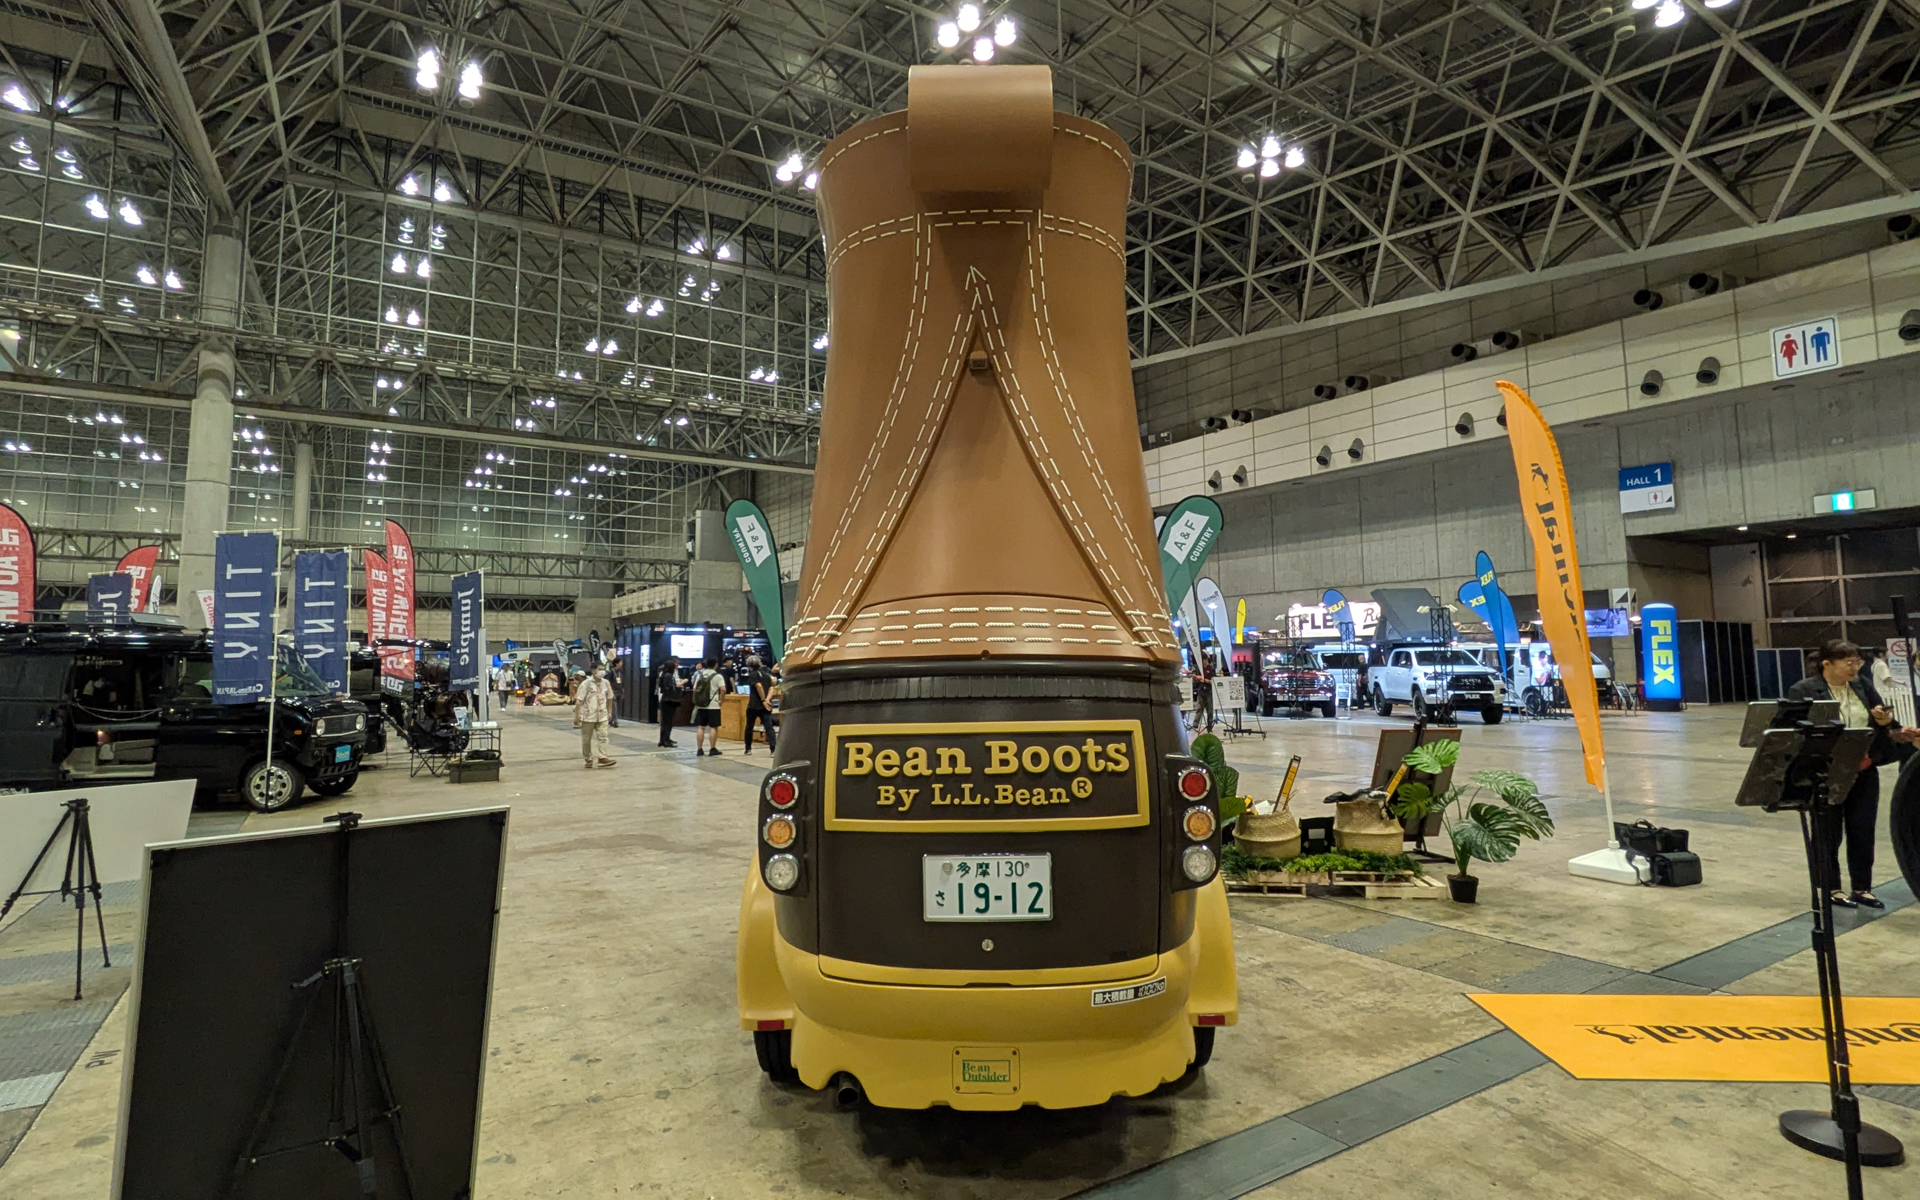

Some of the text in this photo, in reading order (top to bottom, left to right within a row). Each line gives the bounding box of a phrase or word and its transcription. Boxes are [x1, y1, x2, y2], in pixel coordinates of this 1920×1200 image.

[1626, 468, 1662, 486] HALL 1
[1174, 519, 1196, 551] A & F
[1190, 527, 1214, 562] COUNTRY
[1299, 612, 1338, 630] FLE
[1650, 620, 1675, 685] FLEX
[841, 738, 1130, 777] Bean Boots
[876, 785, 920, 812] By
[956, 860, 1025, 878] 多摩 130
[935, 882, 1044, 914] さ 19-12
[963, 1062, 990, 1072] Bean
[963, 1072, 1008, 1082] Outsider
